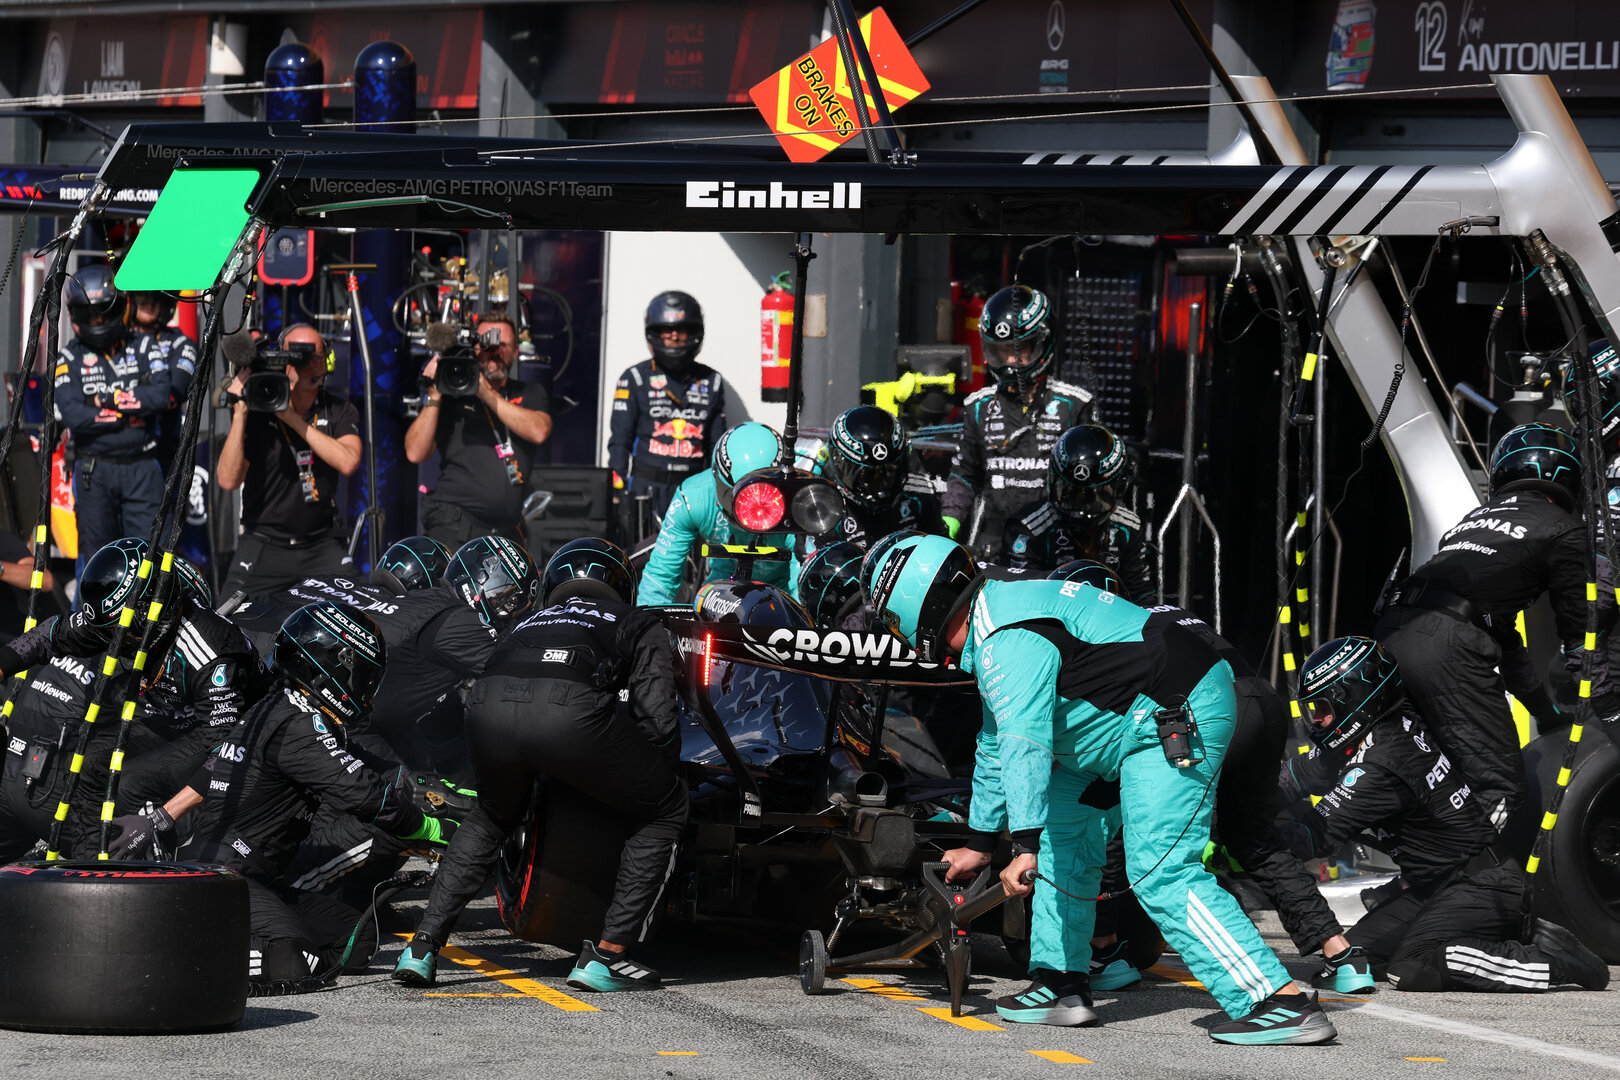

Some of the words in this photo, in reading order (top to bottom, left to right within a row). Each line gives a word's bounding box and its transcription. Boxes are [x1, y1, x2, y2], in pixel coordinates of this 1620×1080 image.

[1415, 1, 1447, 71] 12
[1458, 41, 1620, 72] ANTONELLI
[84, 80, 141, 101] LAWSON
[797, 57, 854, 137] BRAKES
[795, 94, 823, 127] ON
[310, 177, 446, 195] Mercedes-AMG
[450, 179, 545, 196] PETRONAS
[686, 181, 861, 209] Einhell
[649, 406, 708, 420] ORACLE
[113, 568, 137, 602] SOLERA
[702, 590, 741, 615] Microsoft
[333, 613, 367, 640] SOLERA
[344, 633, 377, 658] CROWDSTRIKE
[1314, 651, 1348, 676] SOLERA
[1307, 669, 1339, 691] CROWDSTRIKE
[213, 701, 233, 709] IWC
[321, 687, 355, 717] Einhell
[8, 738, 27, 754] OMP
[1328, 721, 1362, 749] Einhell
[232, 839, 251, 857] OMP
